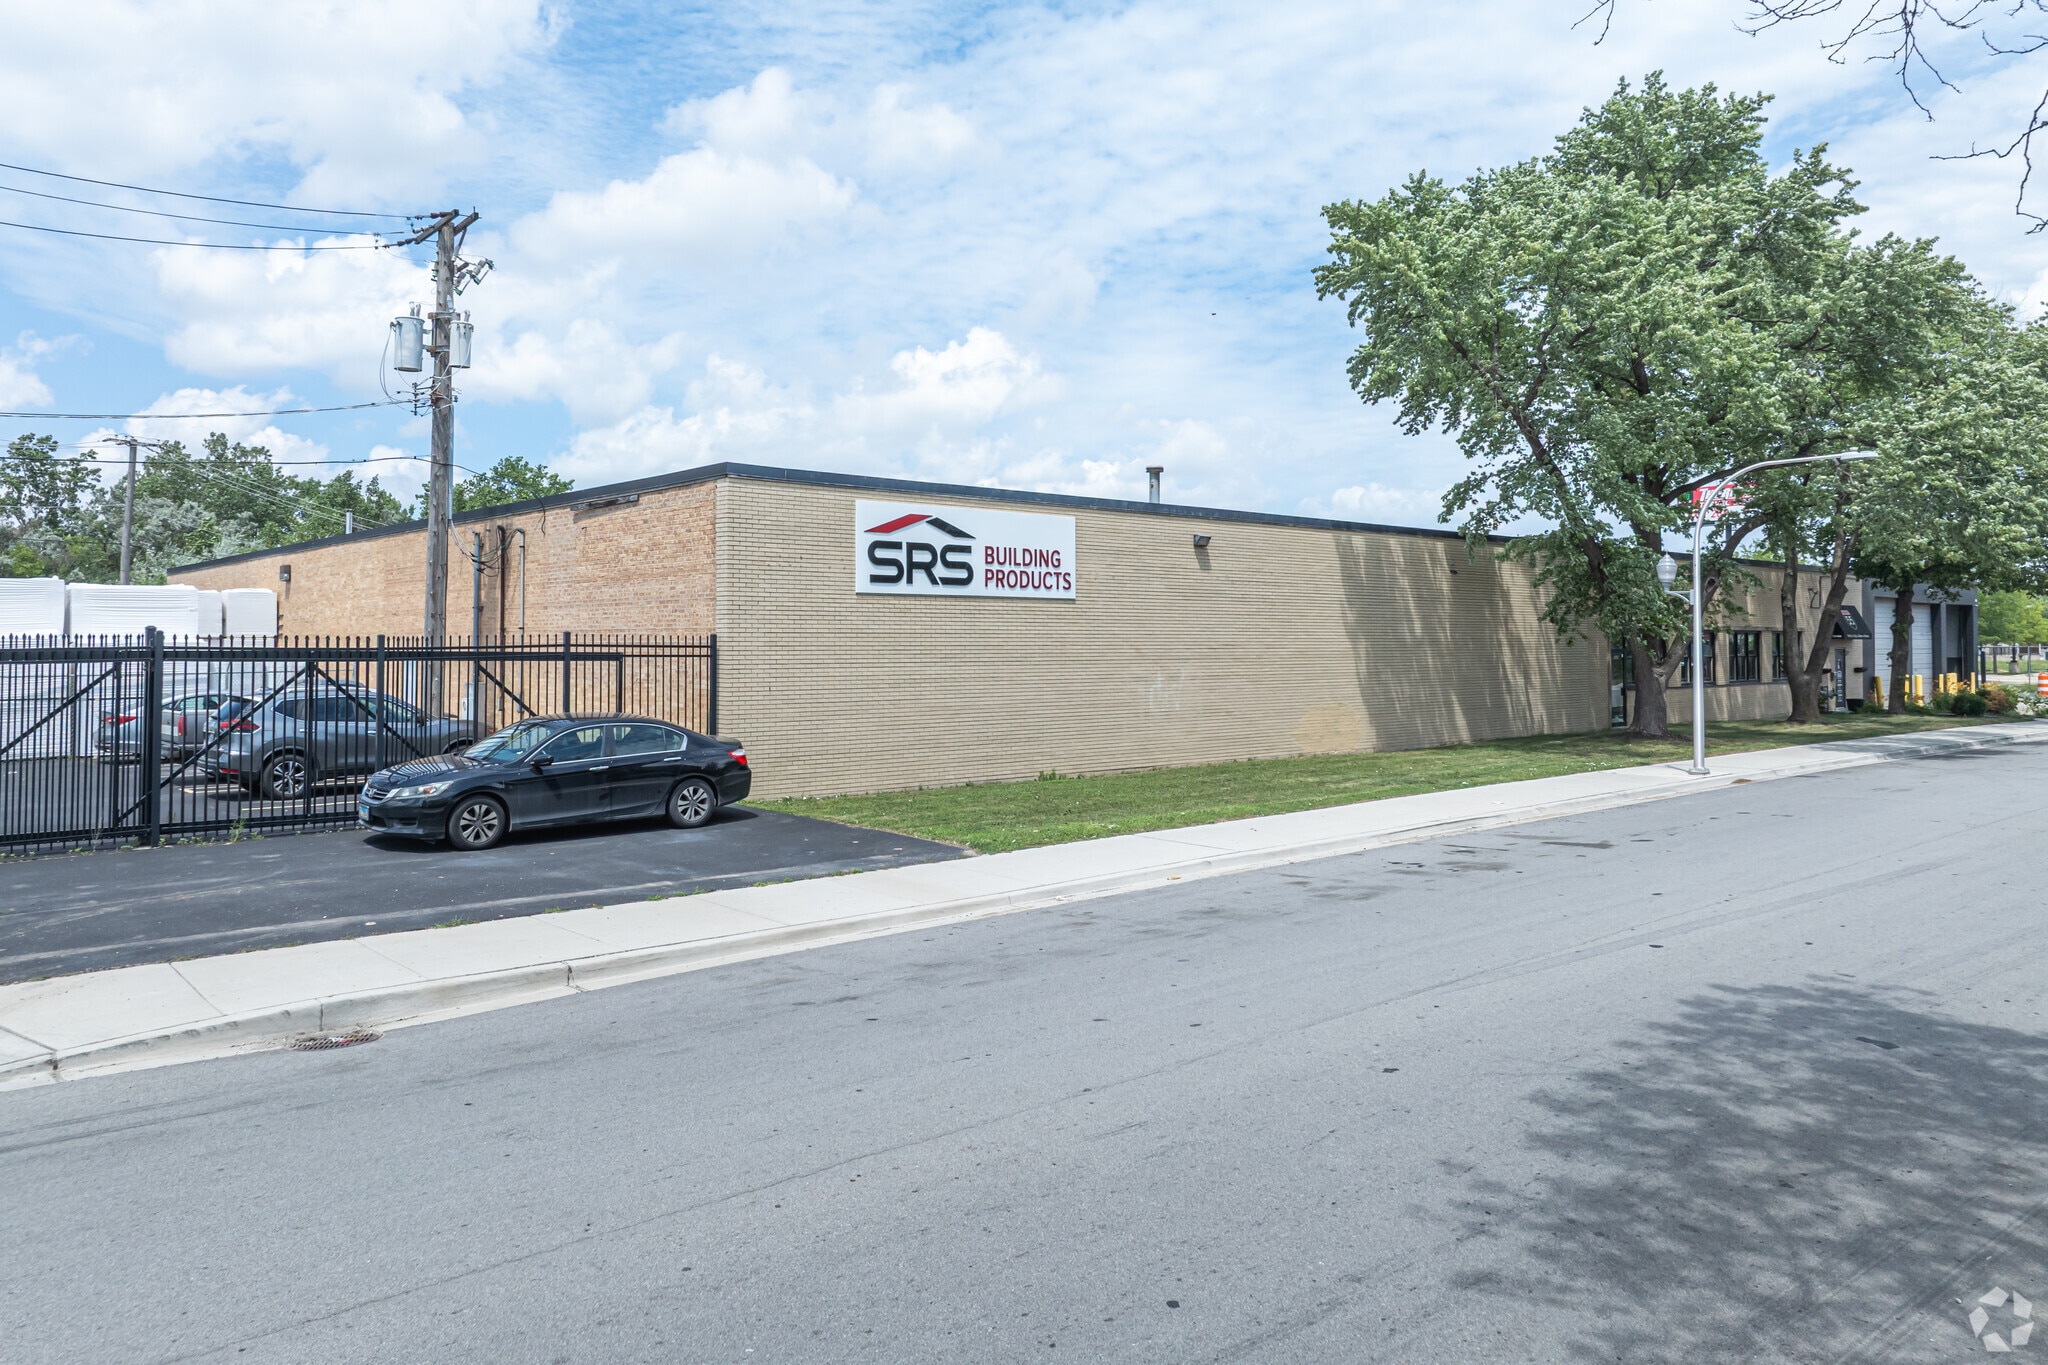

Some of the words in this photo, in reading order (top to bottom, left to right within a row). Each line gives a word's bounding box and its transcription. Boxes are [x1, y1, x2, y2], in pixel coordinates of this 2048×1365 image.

[867, 540, 974, 586] SRS
[984, 546, 1061, 568] BUILDING
[984, 569, 1072, 590] PRODUCTS
